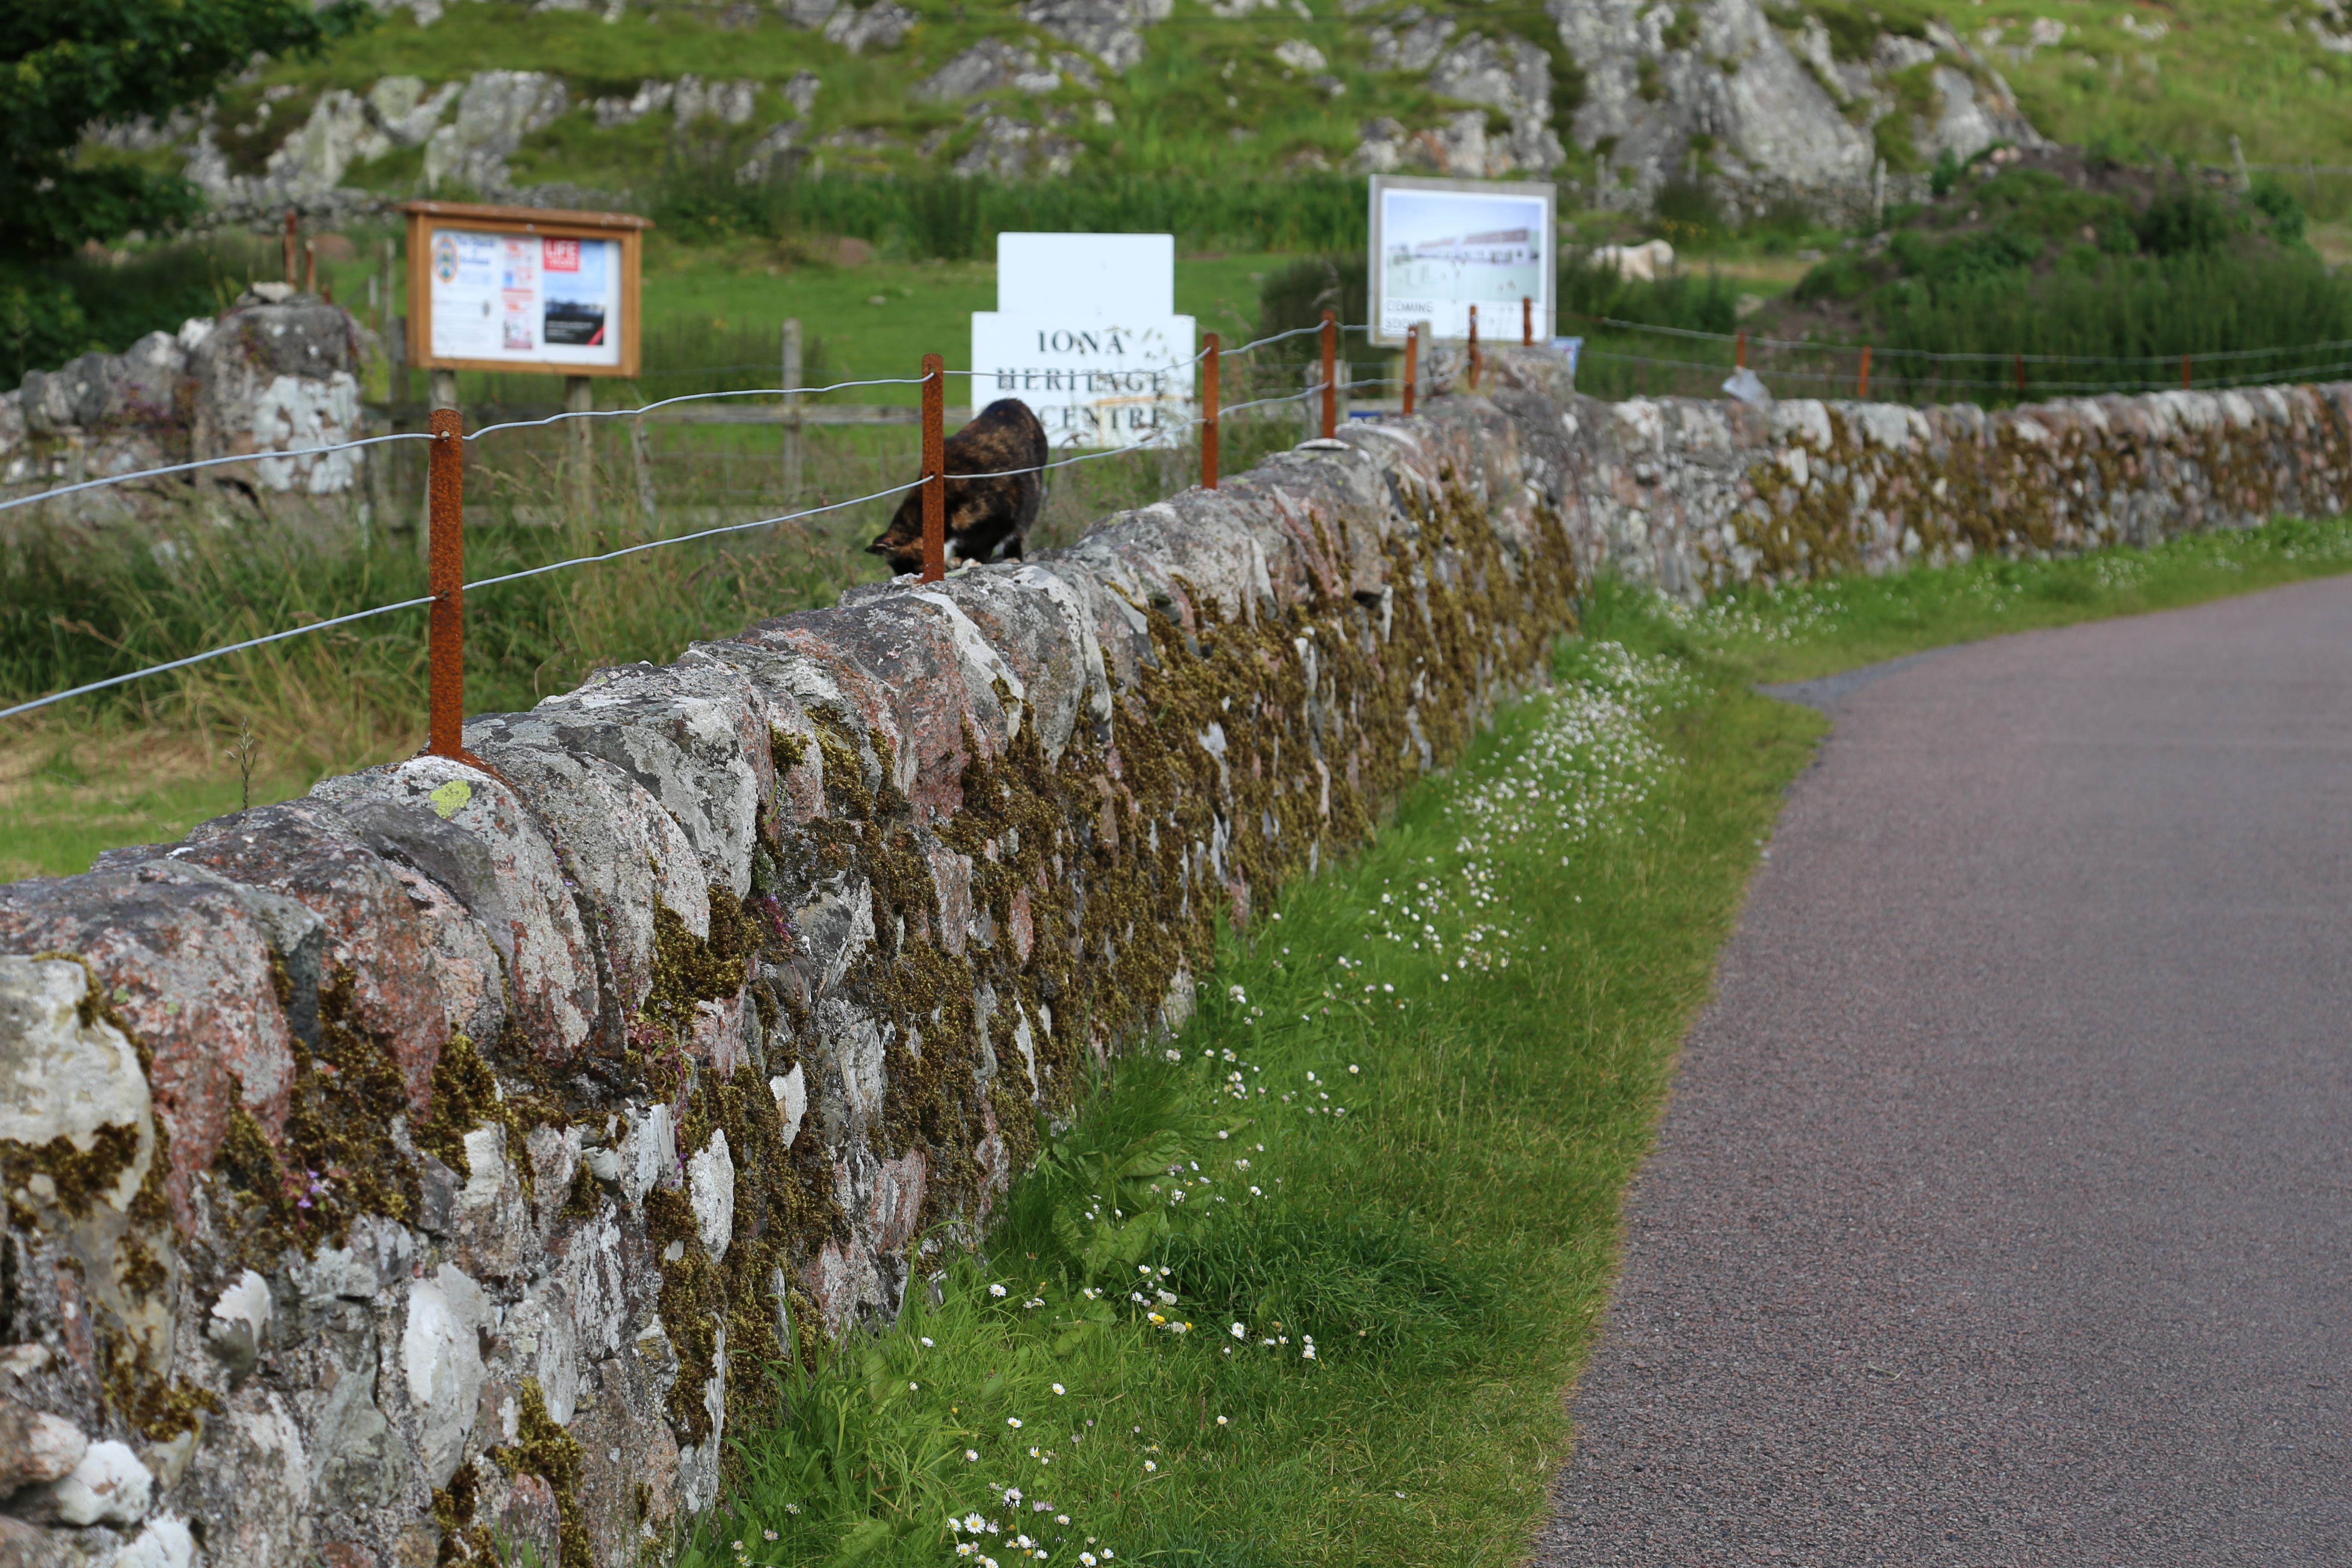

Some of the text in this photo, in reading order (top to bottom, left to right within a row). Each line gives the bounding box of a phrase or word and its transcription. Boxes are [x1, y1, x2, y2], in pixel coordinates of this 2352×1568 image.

[545, 239, 578, 260] LIFE
[1386, 300, 1434, 312] COMING
[1037, 329, 1125, 354] IONA
[996, 368, 1167, 392] HERITAGE
[1038, 404, 1166, 430] CENTRE
